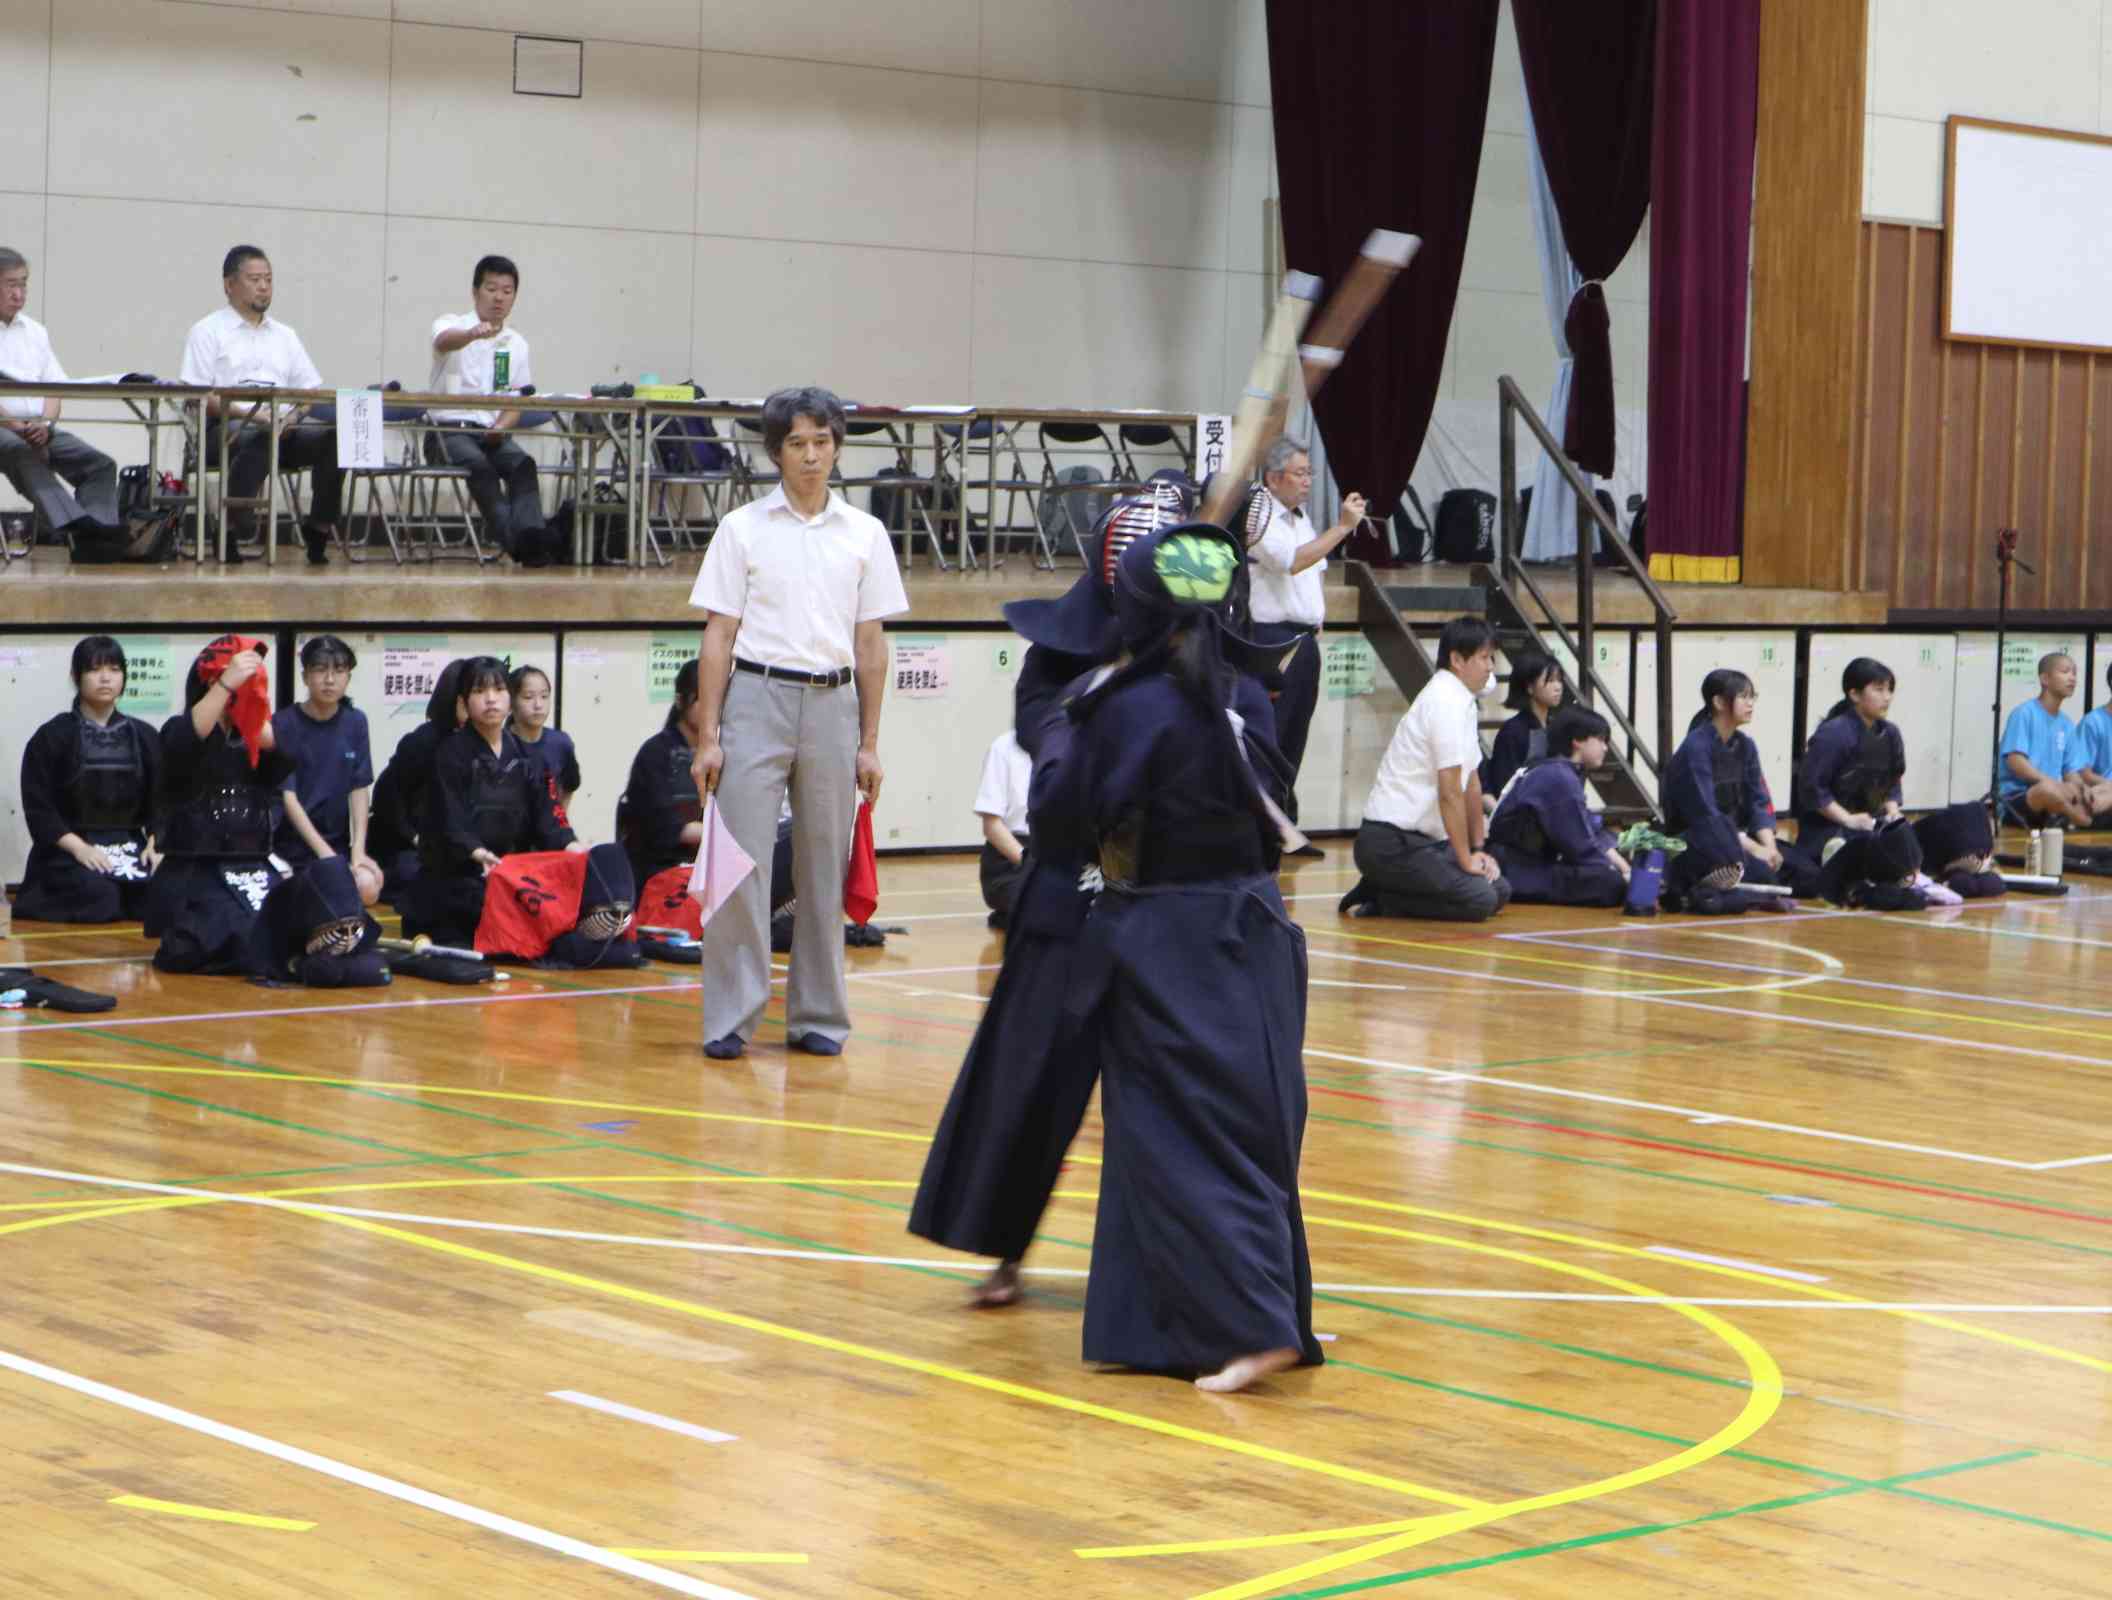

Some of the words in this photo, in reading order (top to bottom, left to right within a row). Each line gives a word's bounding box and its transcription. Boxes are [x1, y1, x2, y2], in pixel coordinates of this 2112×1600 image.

[1206, 420, 1224, 473] 受付
[998, 650, 1008, 666] 6
[1600, 647, 1608, 661] 9
